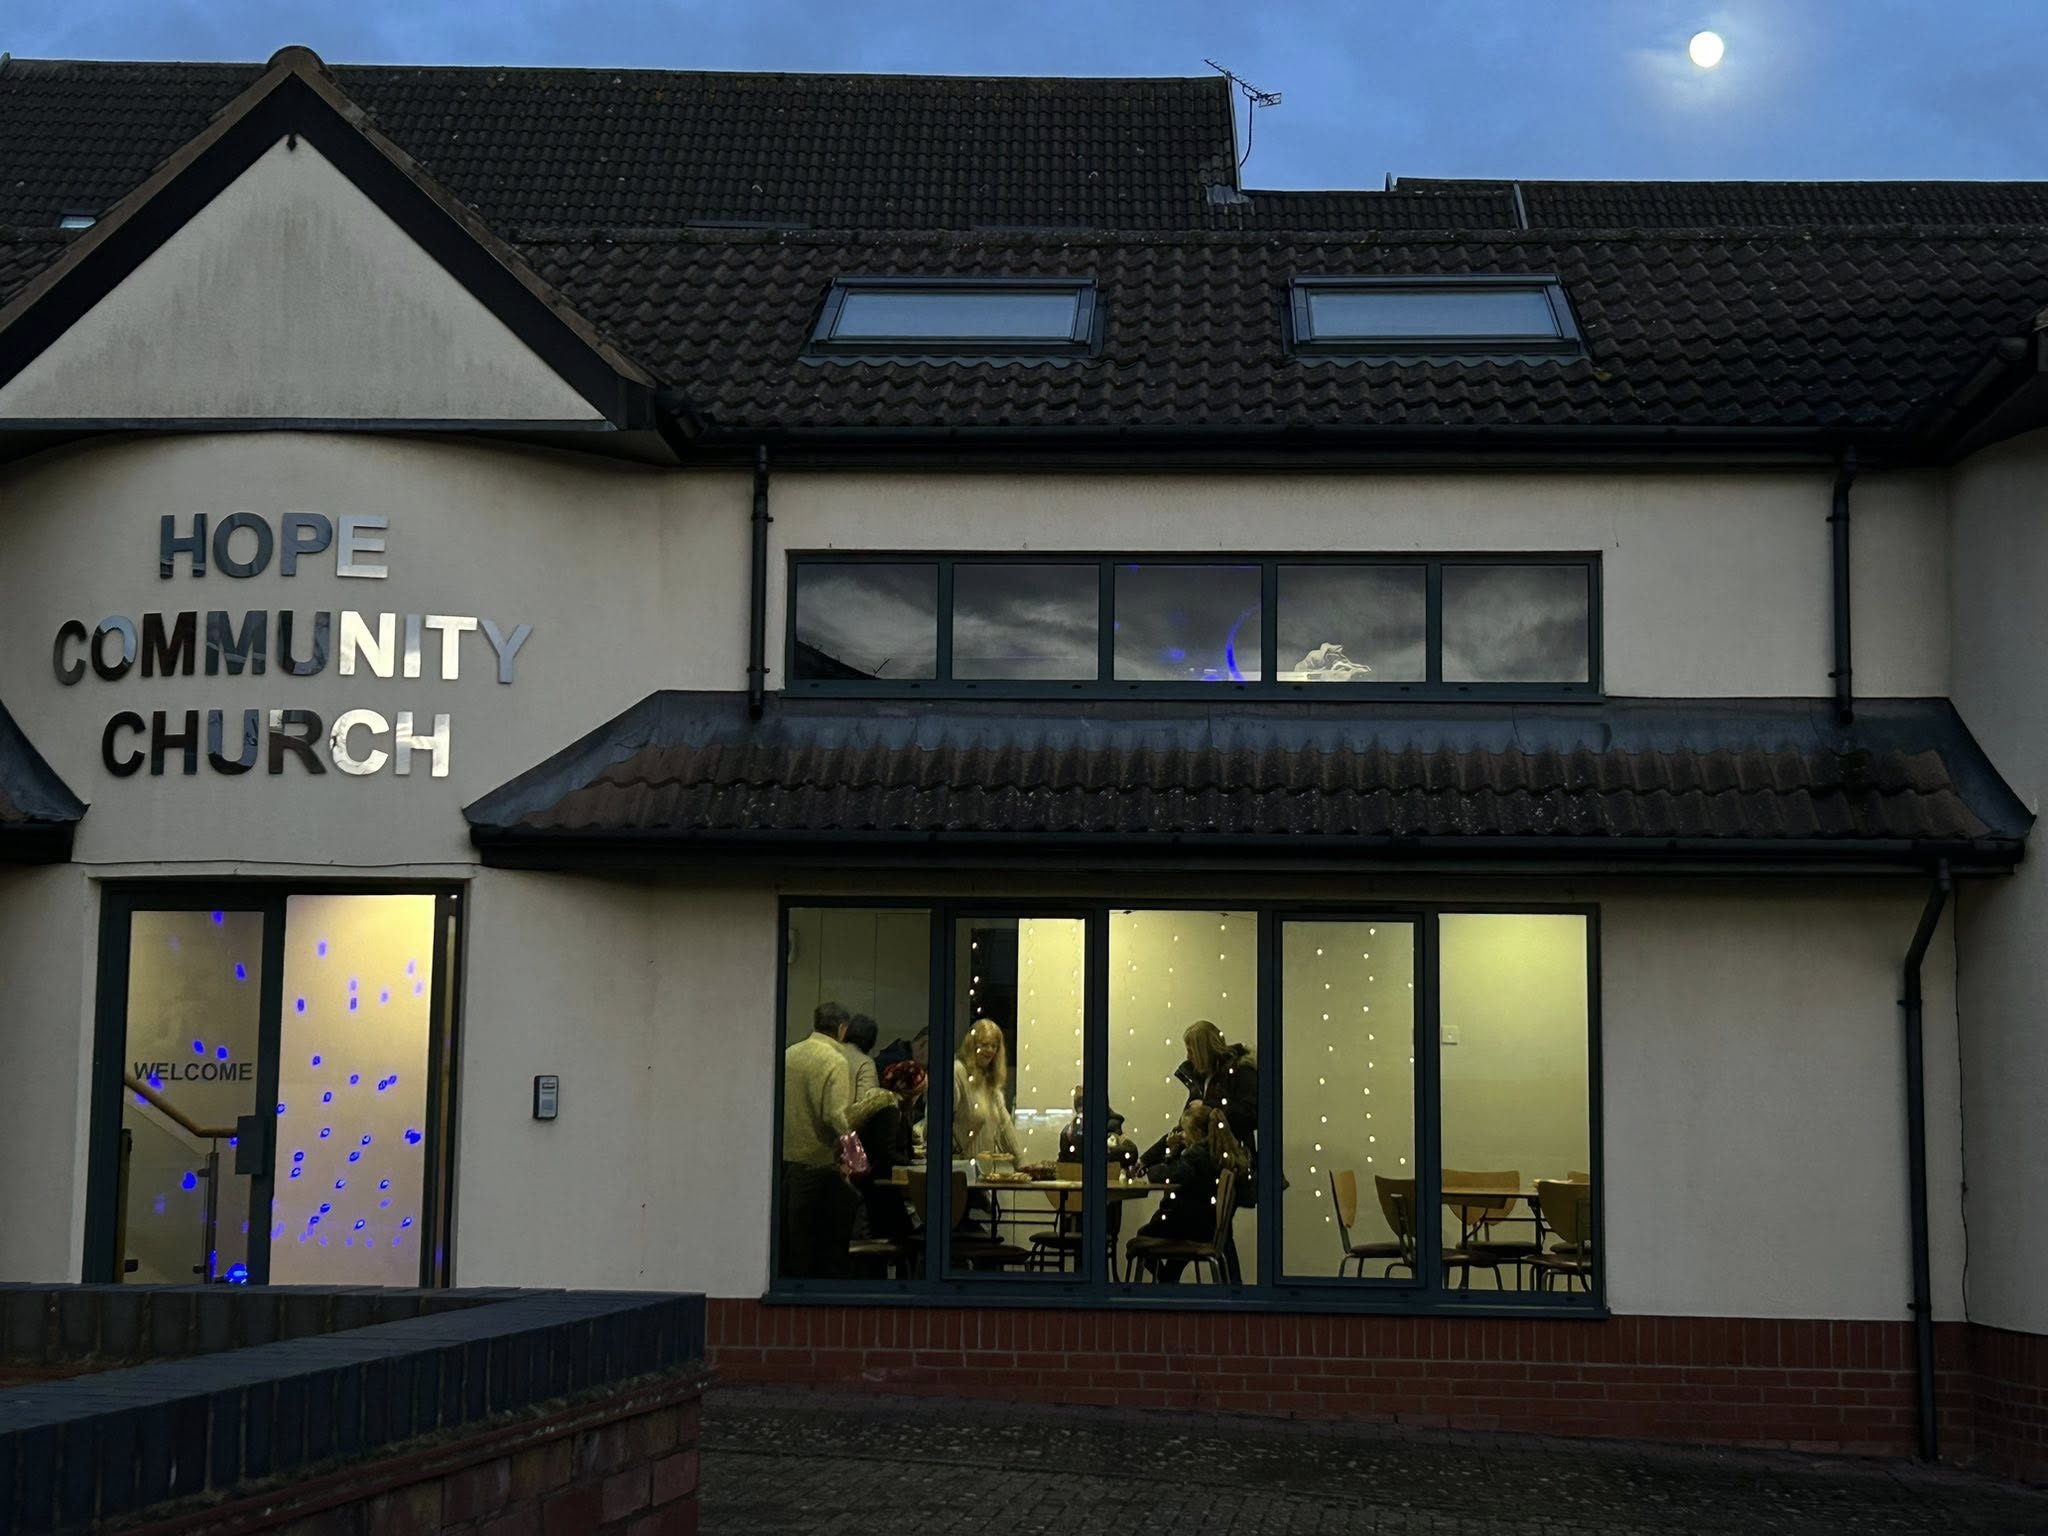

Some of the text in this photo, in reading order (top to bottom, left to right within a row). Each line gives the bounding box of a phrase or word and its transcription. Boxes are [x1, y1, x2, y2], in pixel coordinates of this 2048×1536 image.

[160, 512, 389, 578] HOPE
[52, 610, 534, 685] COMMUNITY
[102, 708, 450, 777] CHURCH
[134, 1062, 252, 1081] WELCOME
